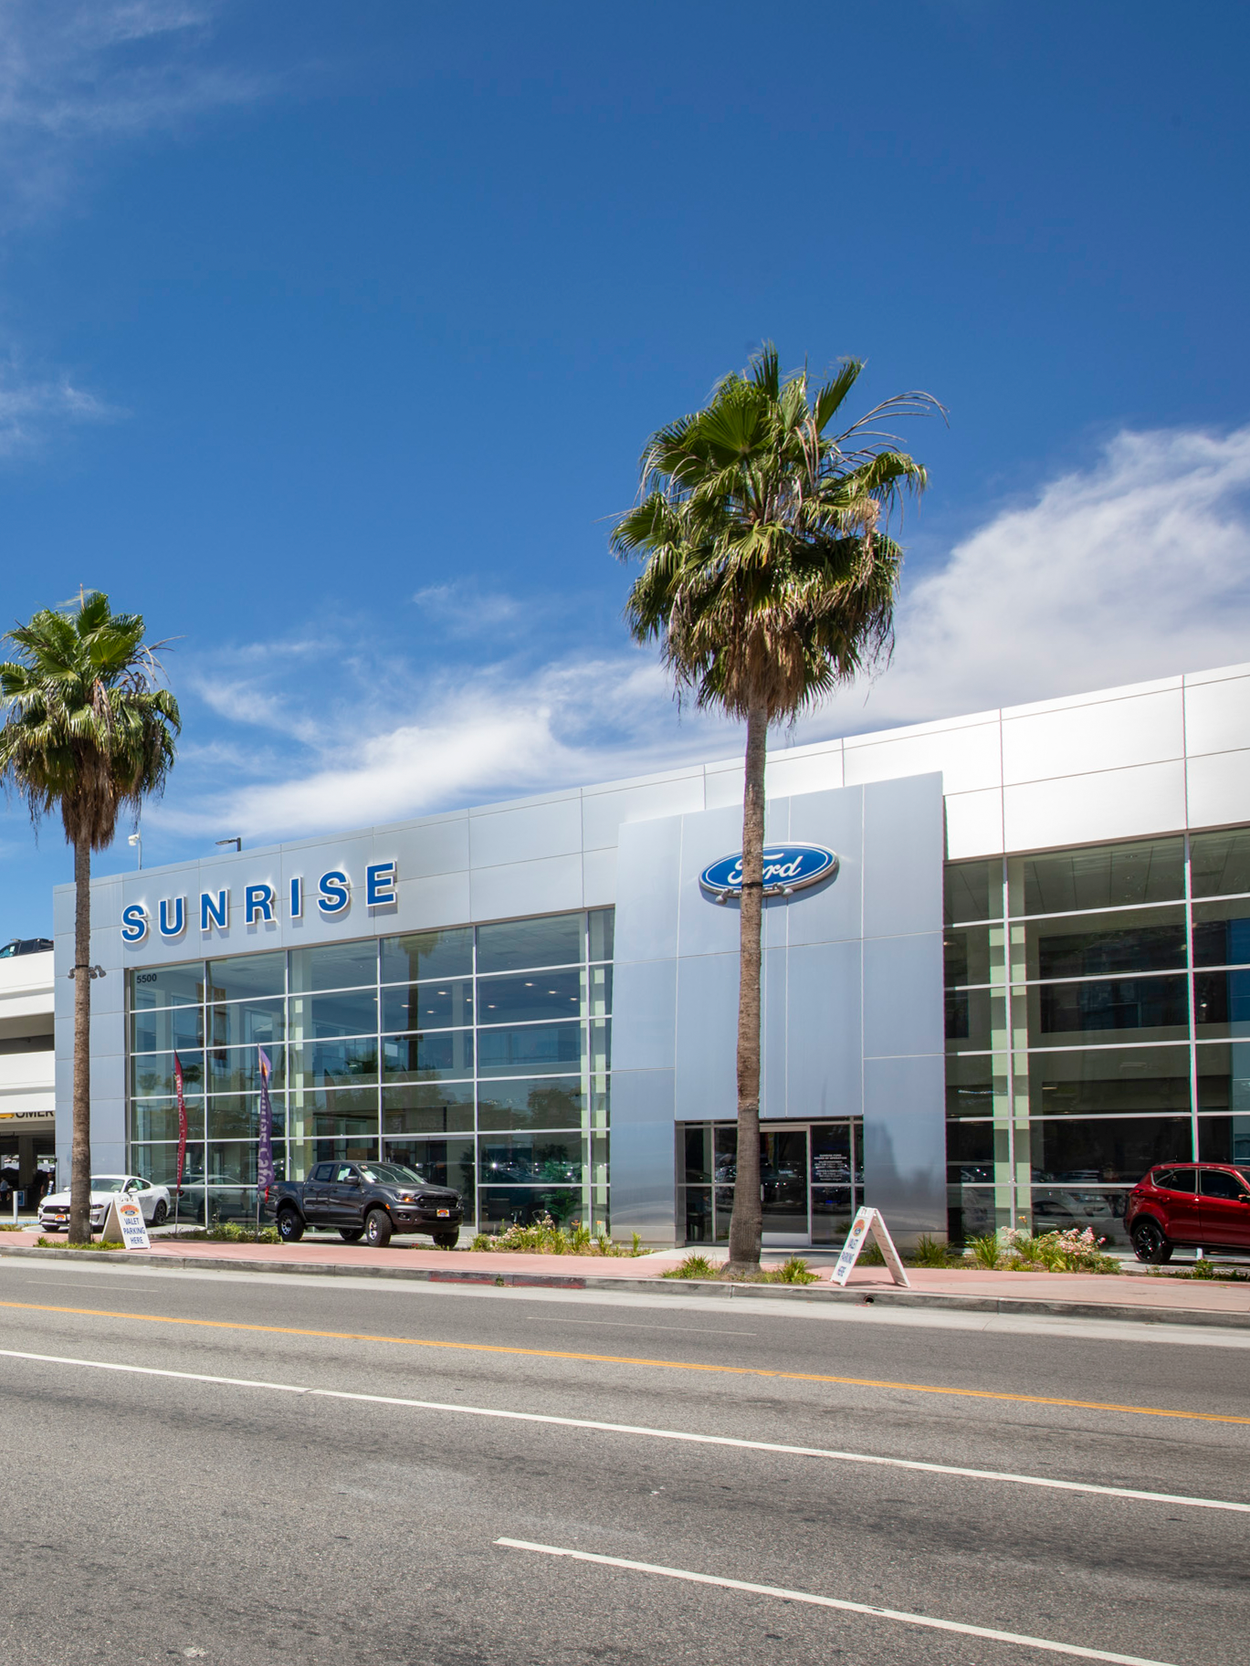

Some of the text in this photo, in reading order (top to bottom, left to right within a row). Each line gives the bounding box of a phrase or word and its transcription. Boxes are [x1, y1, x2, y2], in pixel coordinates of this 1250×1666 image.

[120, 860, 397, 943] SUNRISE
[137, 973, 157, 983] 5500
[124, 1217, 139, 1225] VALET
[123, 1227, 145, 1235] PARKING
